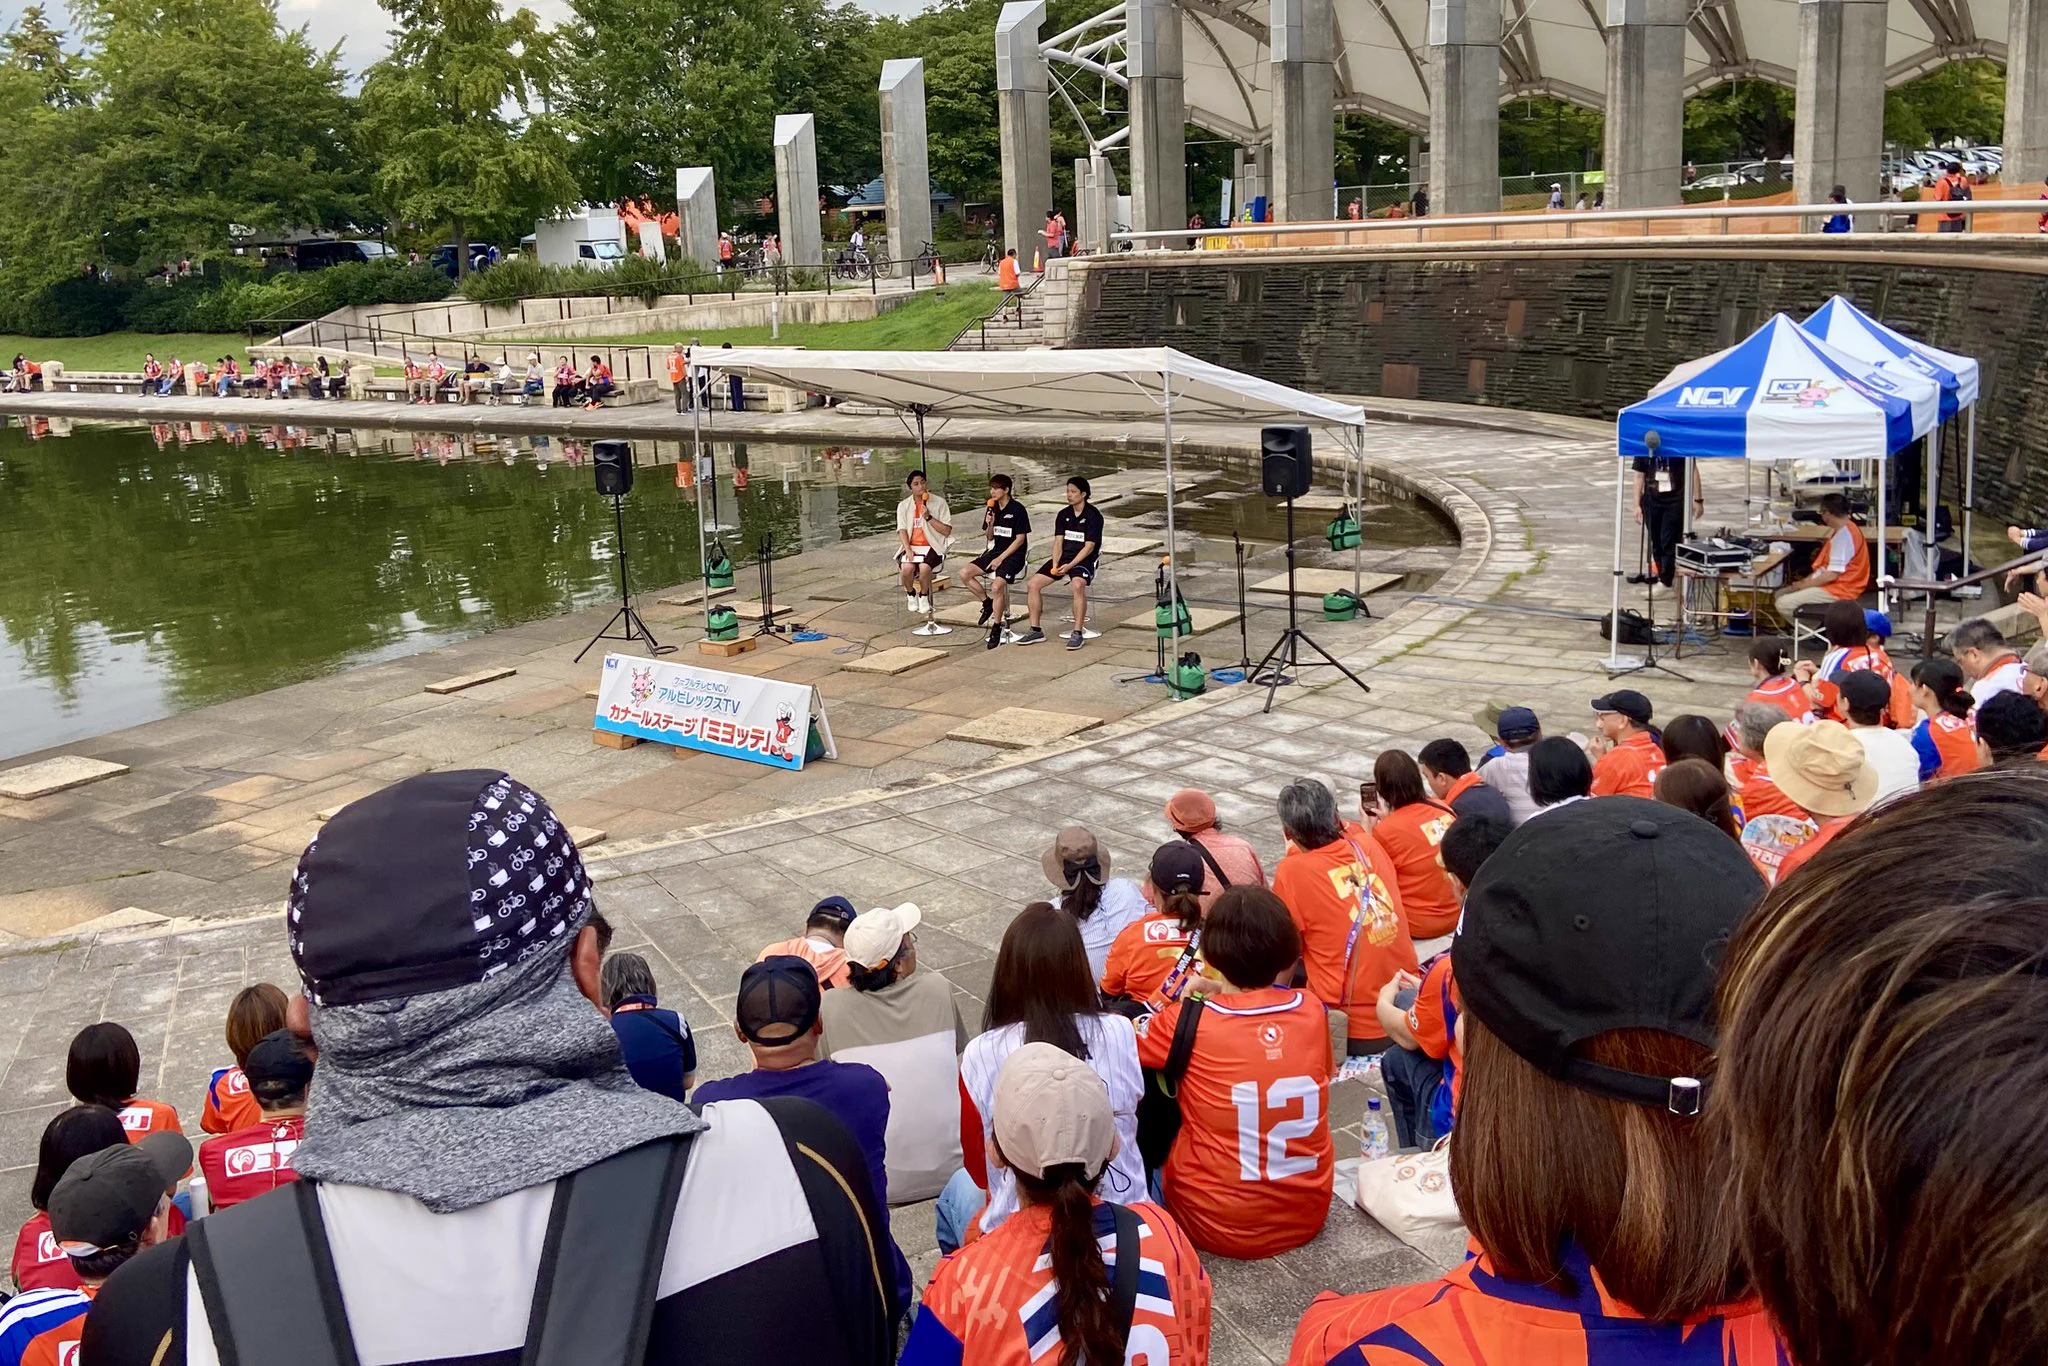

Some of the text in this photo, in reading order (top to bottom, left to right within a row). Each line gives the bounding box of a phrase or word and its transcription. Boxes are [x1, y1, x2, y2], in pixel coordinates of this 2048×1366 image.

[1677, 386, 1750, 405] NCV
[1777, 383, 1800, 391] NCV
[658, 687, 742, 714] アルビレックスTV
[609, 704, 772, 753] カナールステージ「ミヨッテ」
[1231, 1075, 1320, 1181] 12
